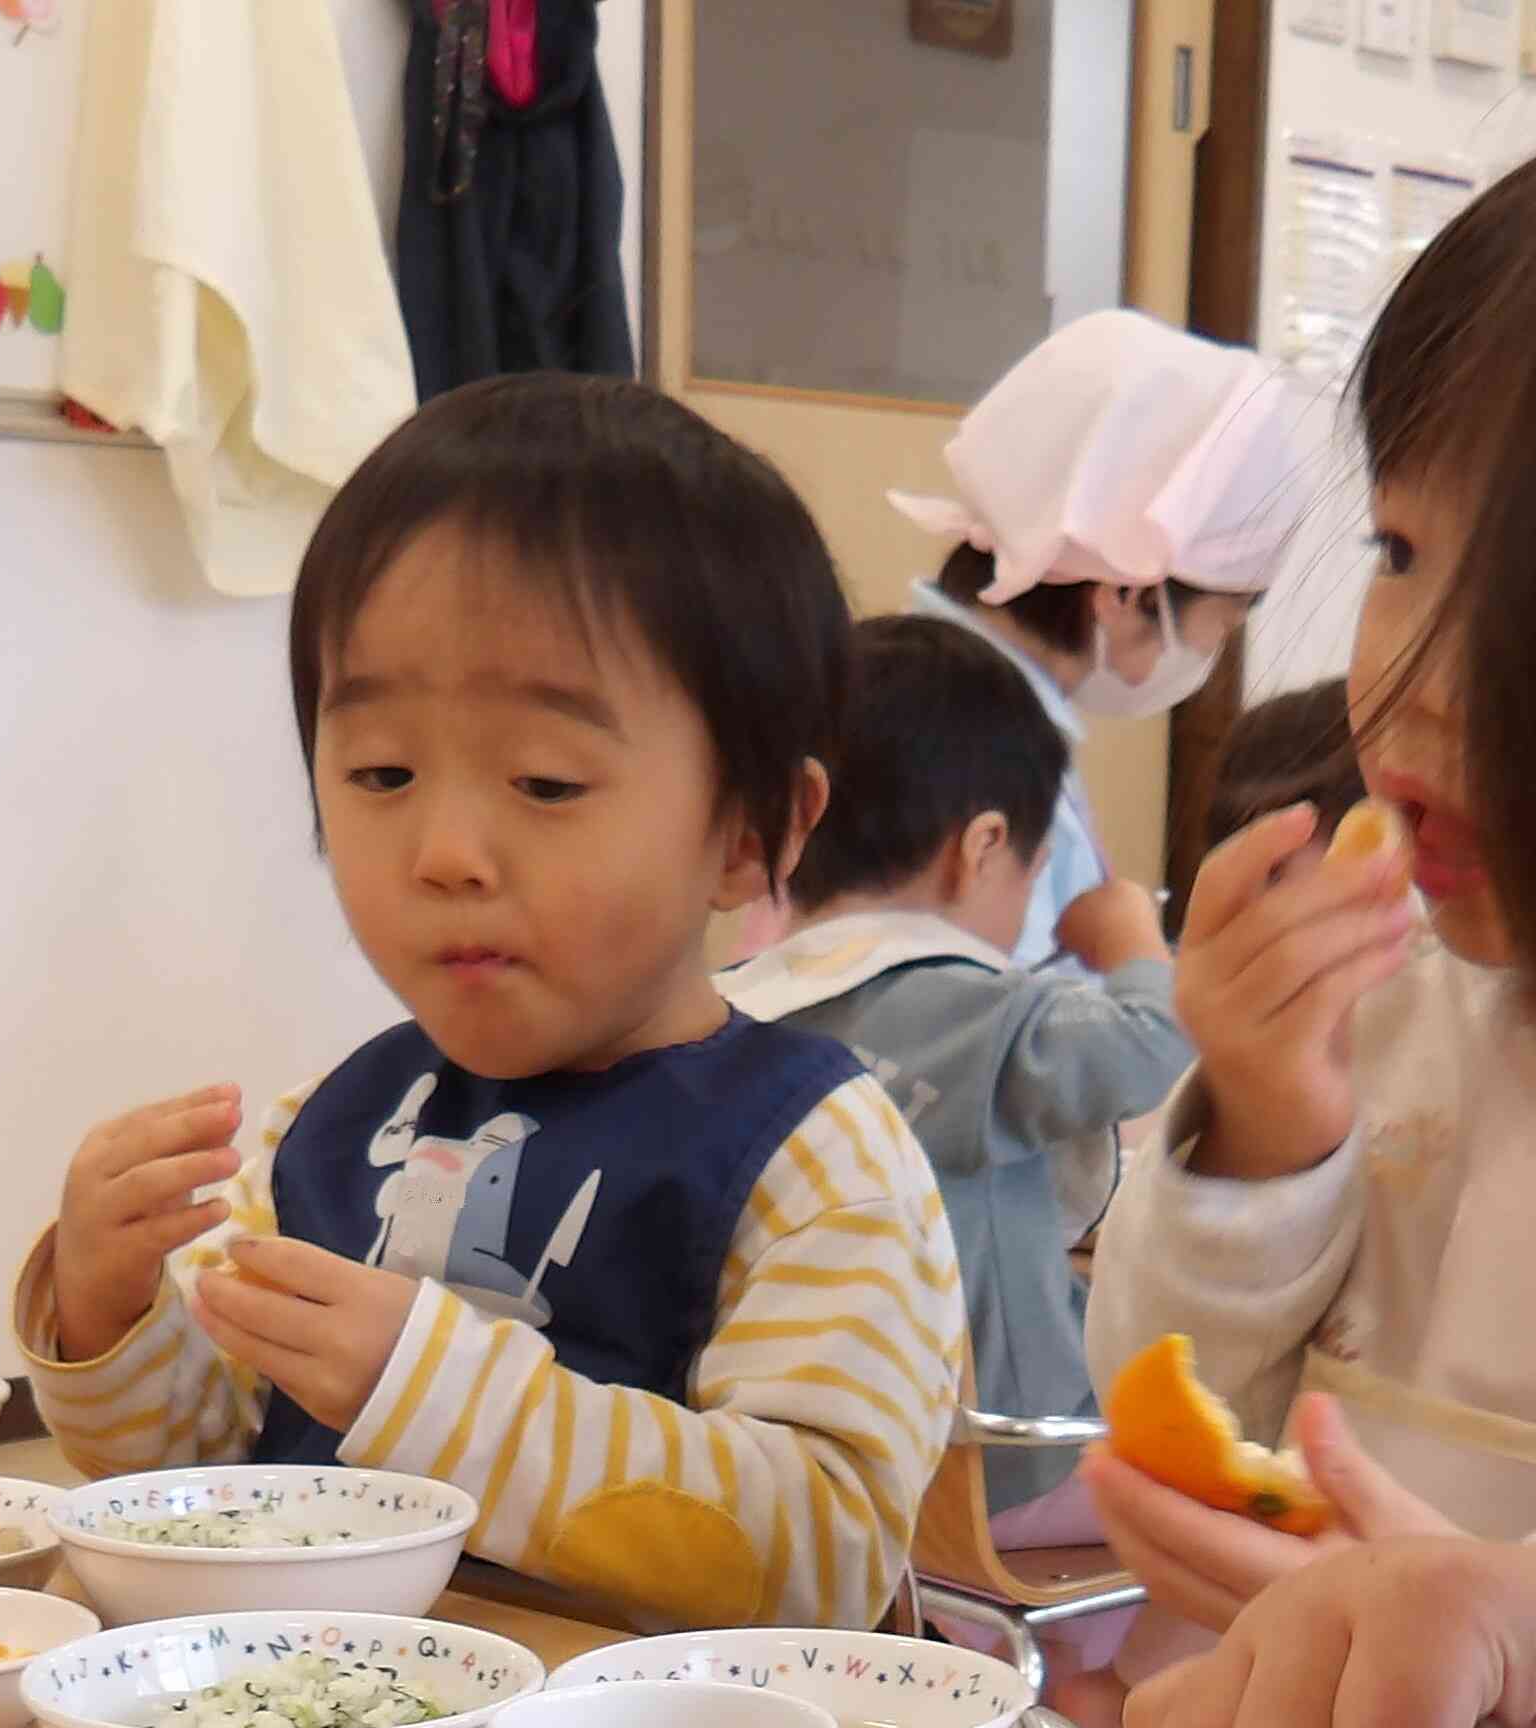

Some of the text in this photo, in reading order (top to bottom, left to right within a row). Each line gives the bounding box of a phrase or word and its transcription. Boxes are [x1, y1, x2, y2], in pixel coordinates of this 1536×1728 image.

[313, 1476, 327, 1496] I
[117, 1650, 133, 1674] K
[208, 1626, 231, 1649] M
[266, 1633, 293, 1661] N
[321, 1626, 343, 1647] O
[368, 1639, 384, 1660] P
[418, 1635, 440, 1659] Q
[489, 1669, 502, 1690] S
[751, 1666, 770, 1688] U
[801, 1647, 818, 1669] V
[845, 1654, 871, 1680] W
[897, 1661, 916, 1686] X
[968, 1672, 983, 1696] Z
